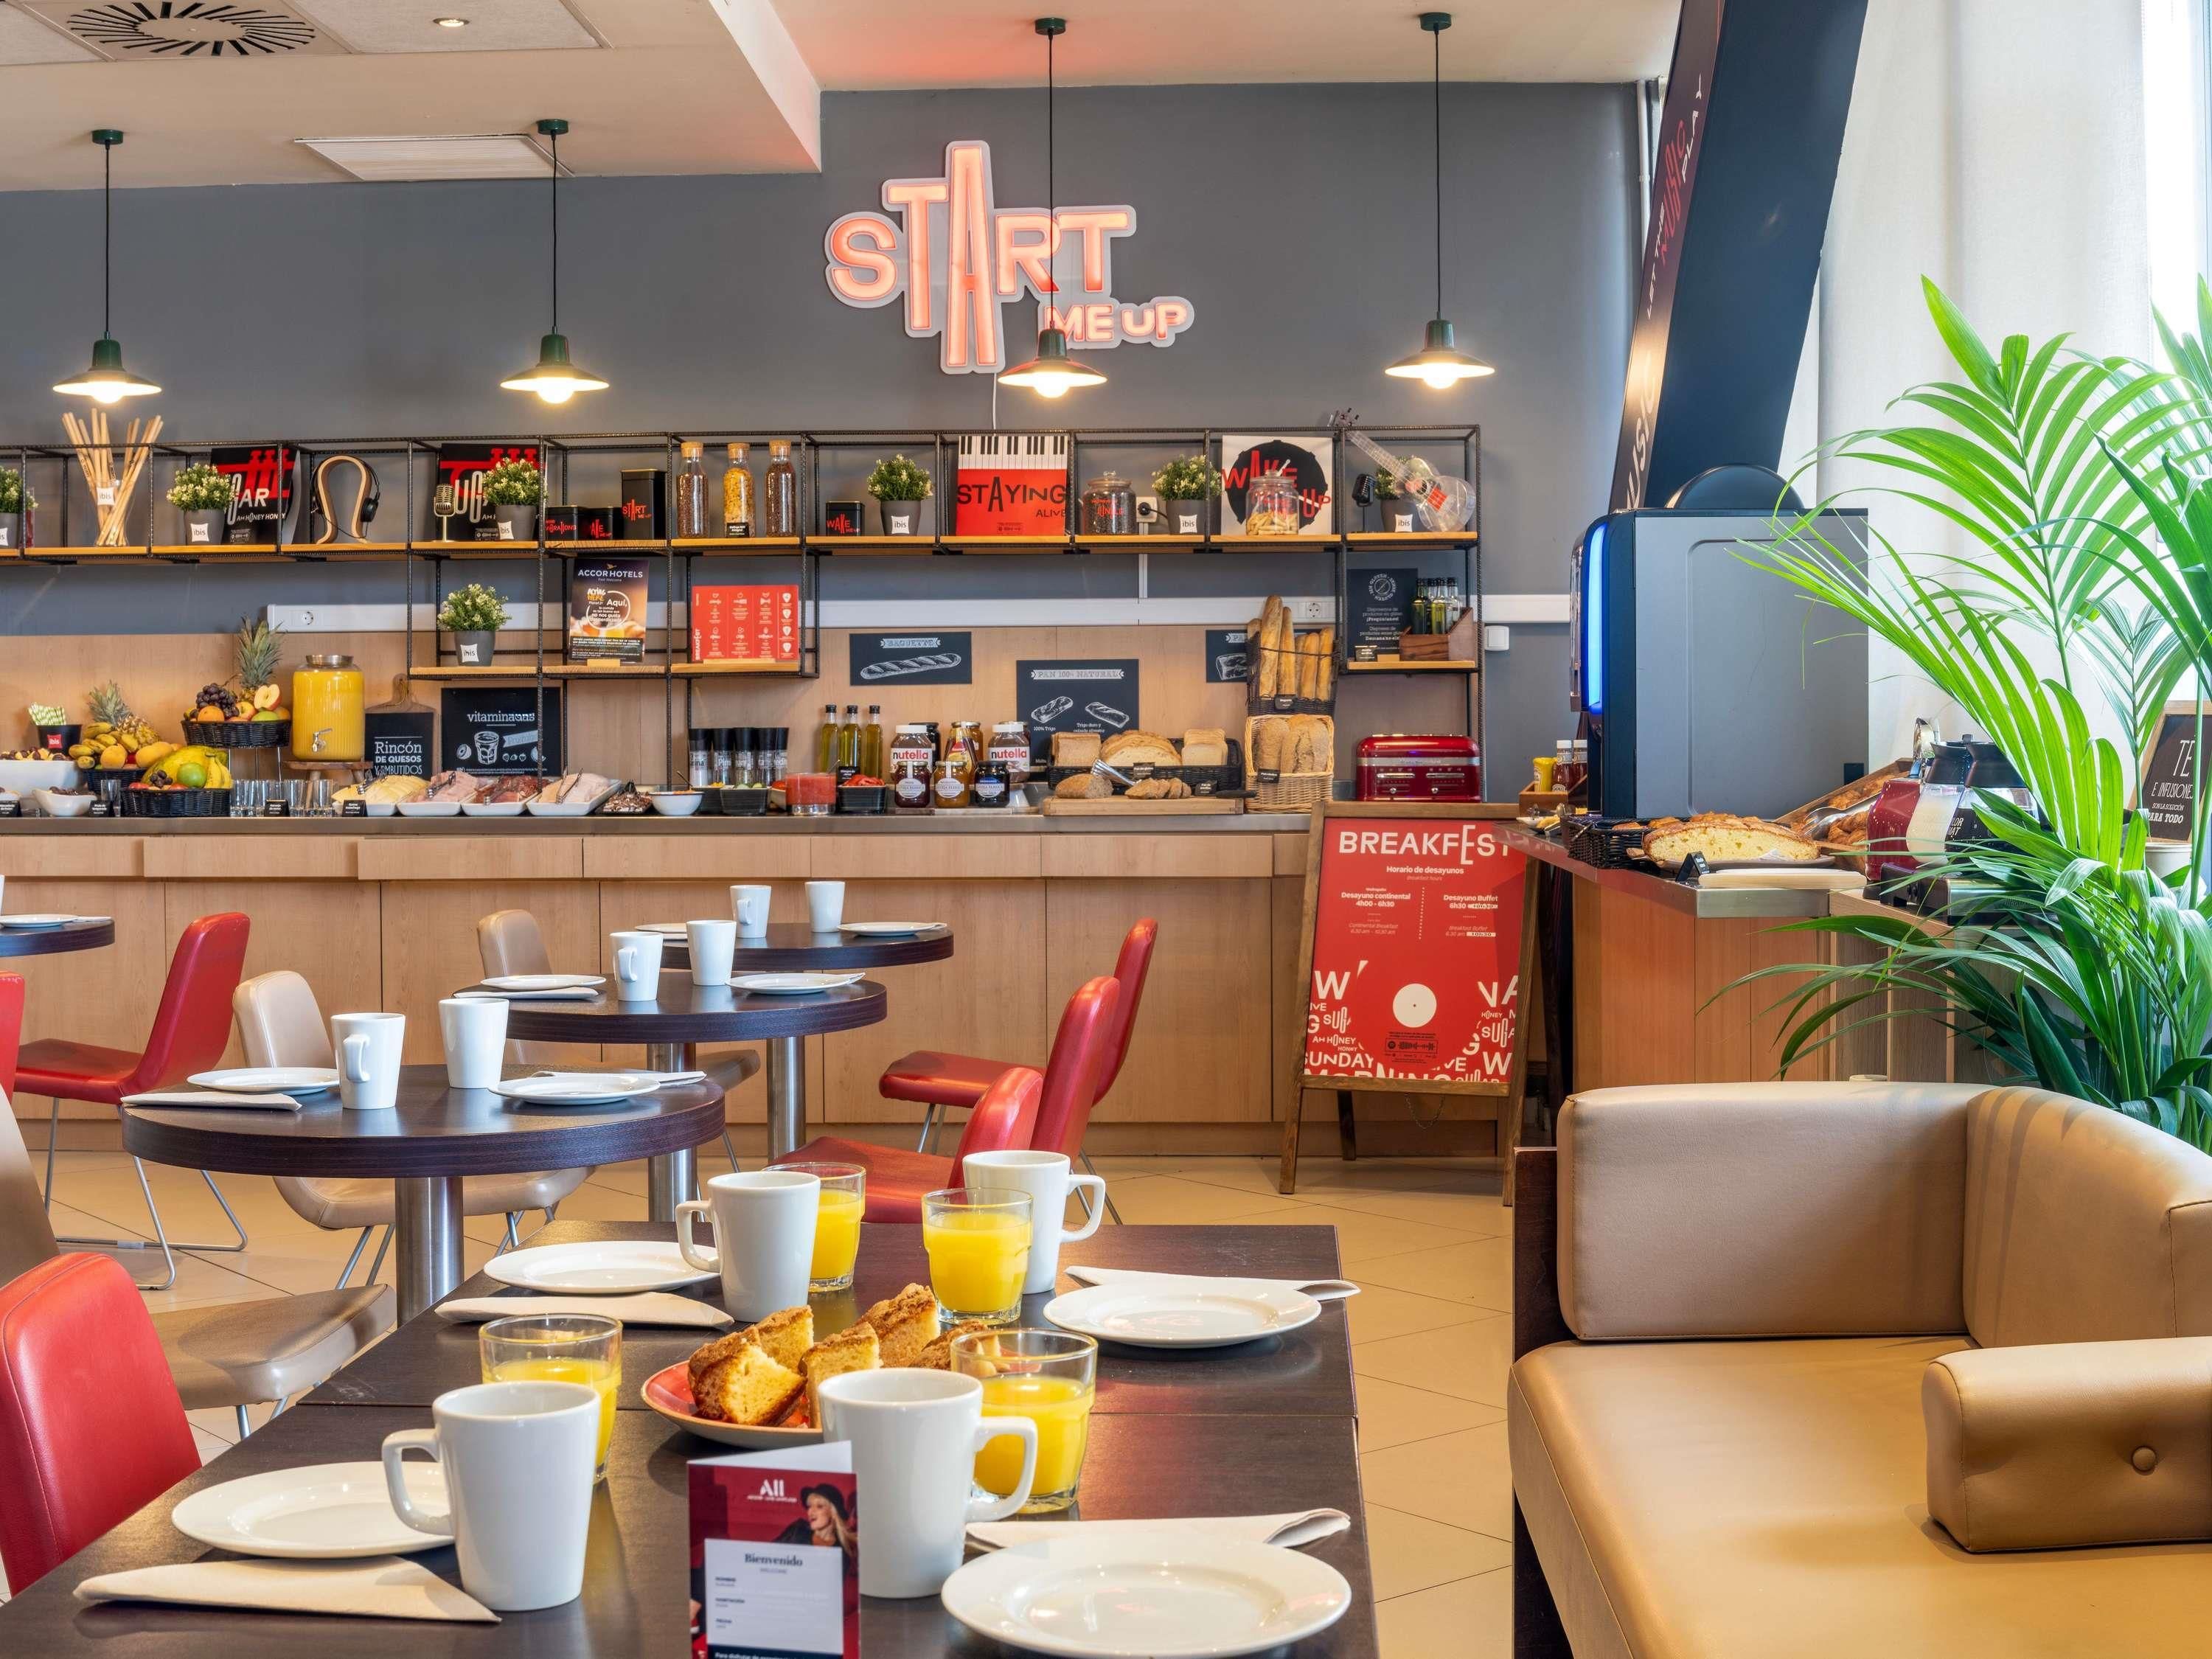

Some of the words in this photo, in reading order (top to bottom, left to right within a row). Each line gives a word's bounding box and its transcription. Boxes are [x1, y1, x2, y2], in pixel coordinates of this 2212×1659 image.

[830, 147, 1130, 366] START
[1044, 305, 1114, 341] ME
[1121, 303, 1187, 340] UP
[1627, 349, 1655, 509] USIC
[957, 476, 1066, 512] STAYING
[622, 498, 647, 521] START
[827, 514, 850, 534] WAKE
[1182, 520, 1195, 528] ibis
[375, 741, 422, 754] Rincón
[893, 750, 928, 759] nutella
[991, 749, 1027, 759] nutella
[2151, 782, 2158, 796] E
[2165, 813, 2183, 824] TODO
[1425, 866, 1464, 875] desayunos
[1481, 1010, 1503, 1019] HONEY
[1326, 1034, 1356, 1046] HONEY
[760, 1479, 785, 1497] All
[745, 1553, 803, 1567] Bienvenido
